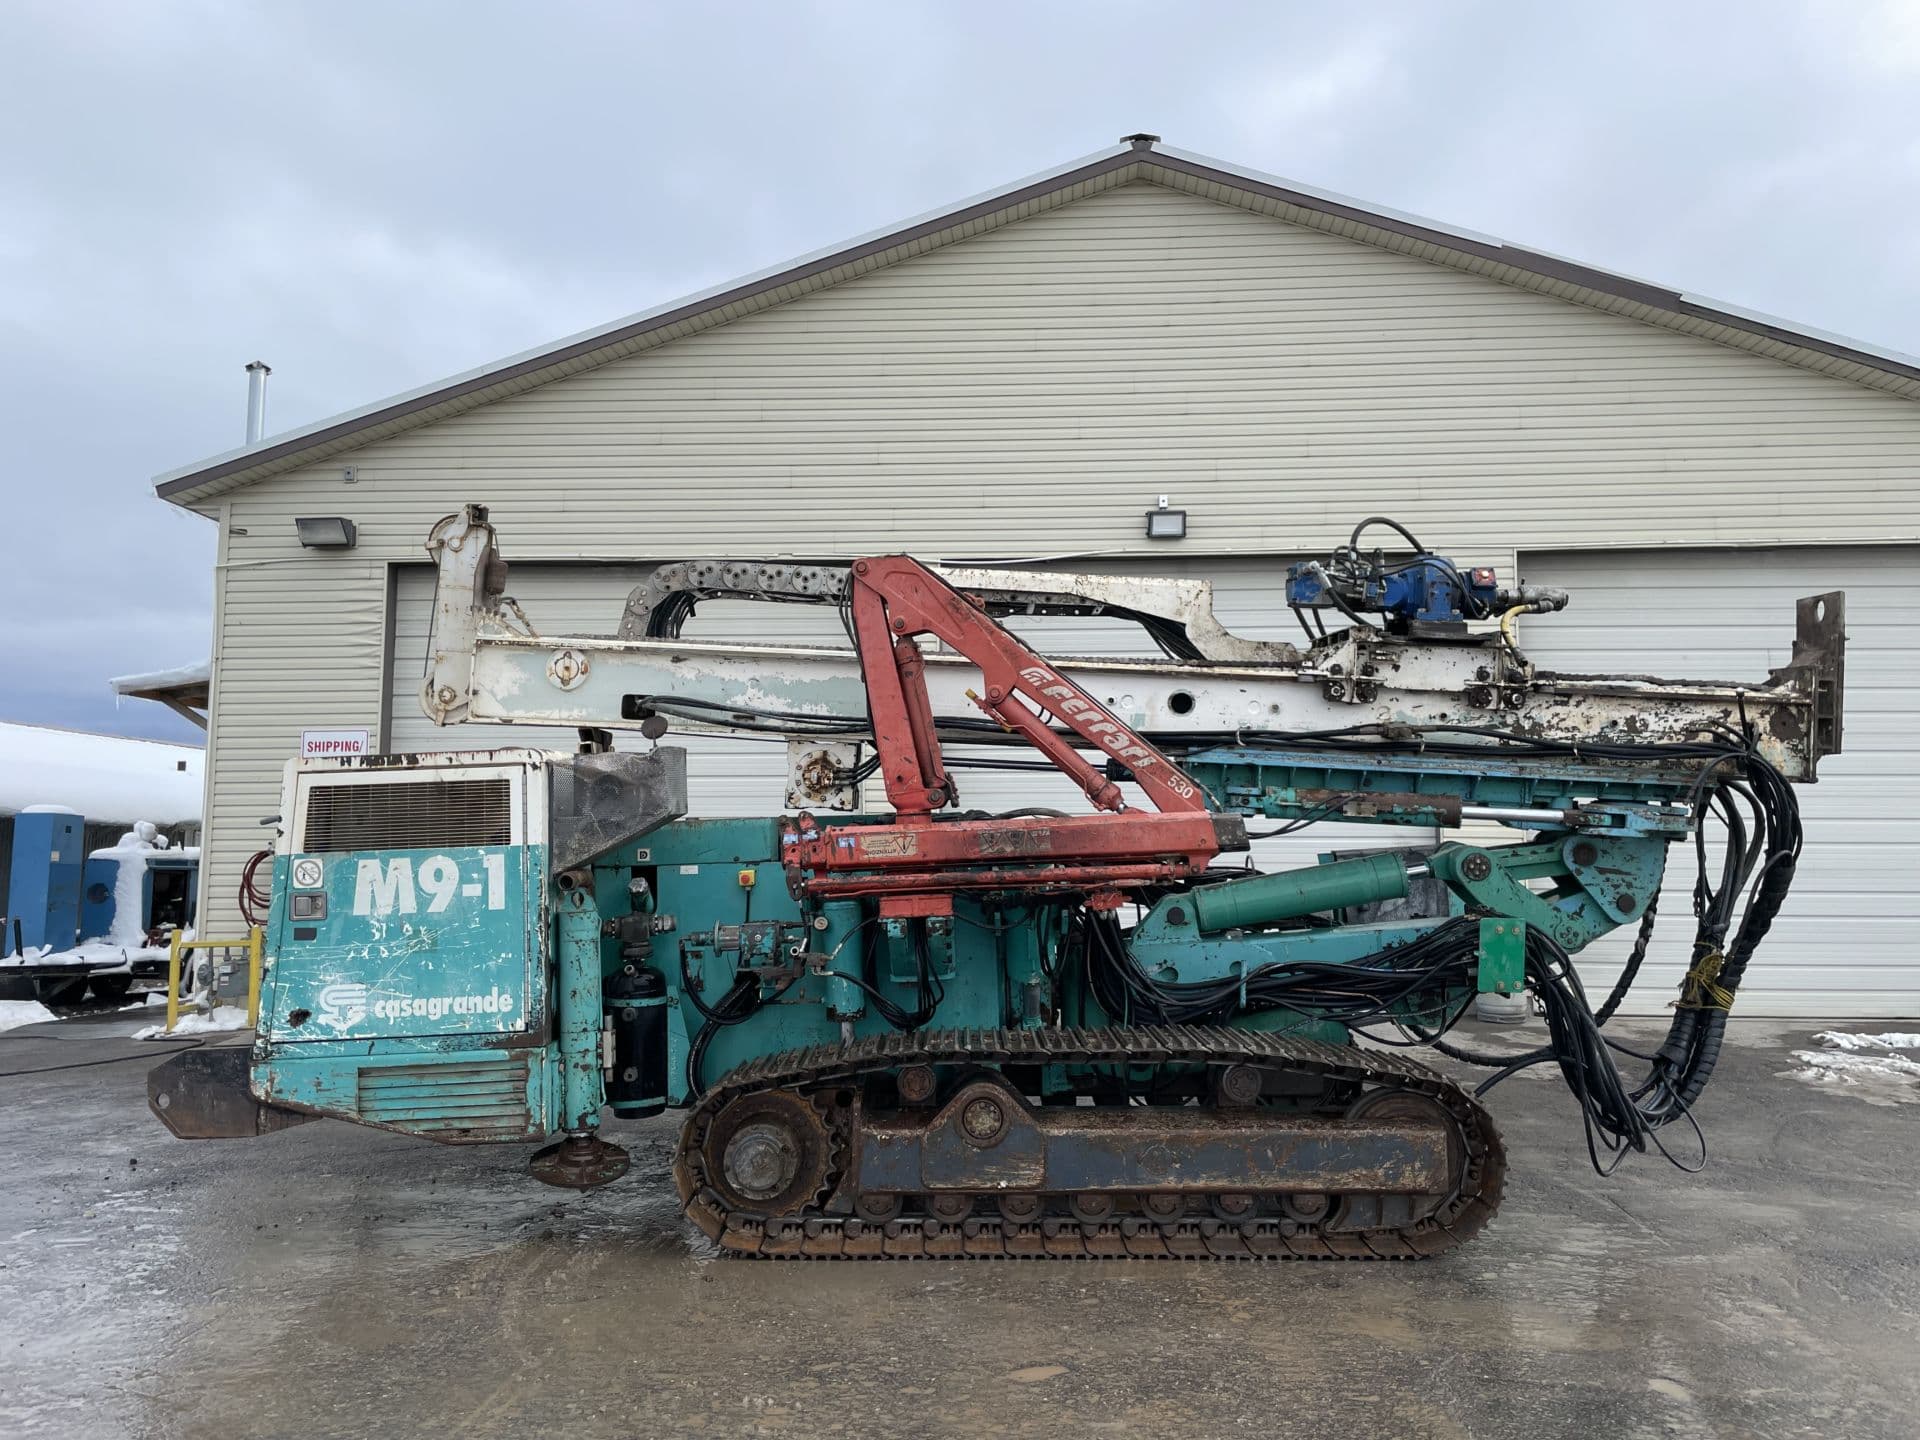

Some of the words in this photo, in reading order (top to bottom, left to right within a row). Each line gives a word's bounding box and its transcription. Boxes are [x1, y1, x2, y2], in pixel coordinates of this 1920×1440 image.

[1042, 685, 1157, 768] Ferrari
[307, 740, 364, 753] SHIPPING/
[1166, 775, 1194, 800] 530
[352, 853, 506, 916] M9-1
[374, 986, 513, 1021] casagrande
